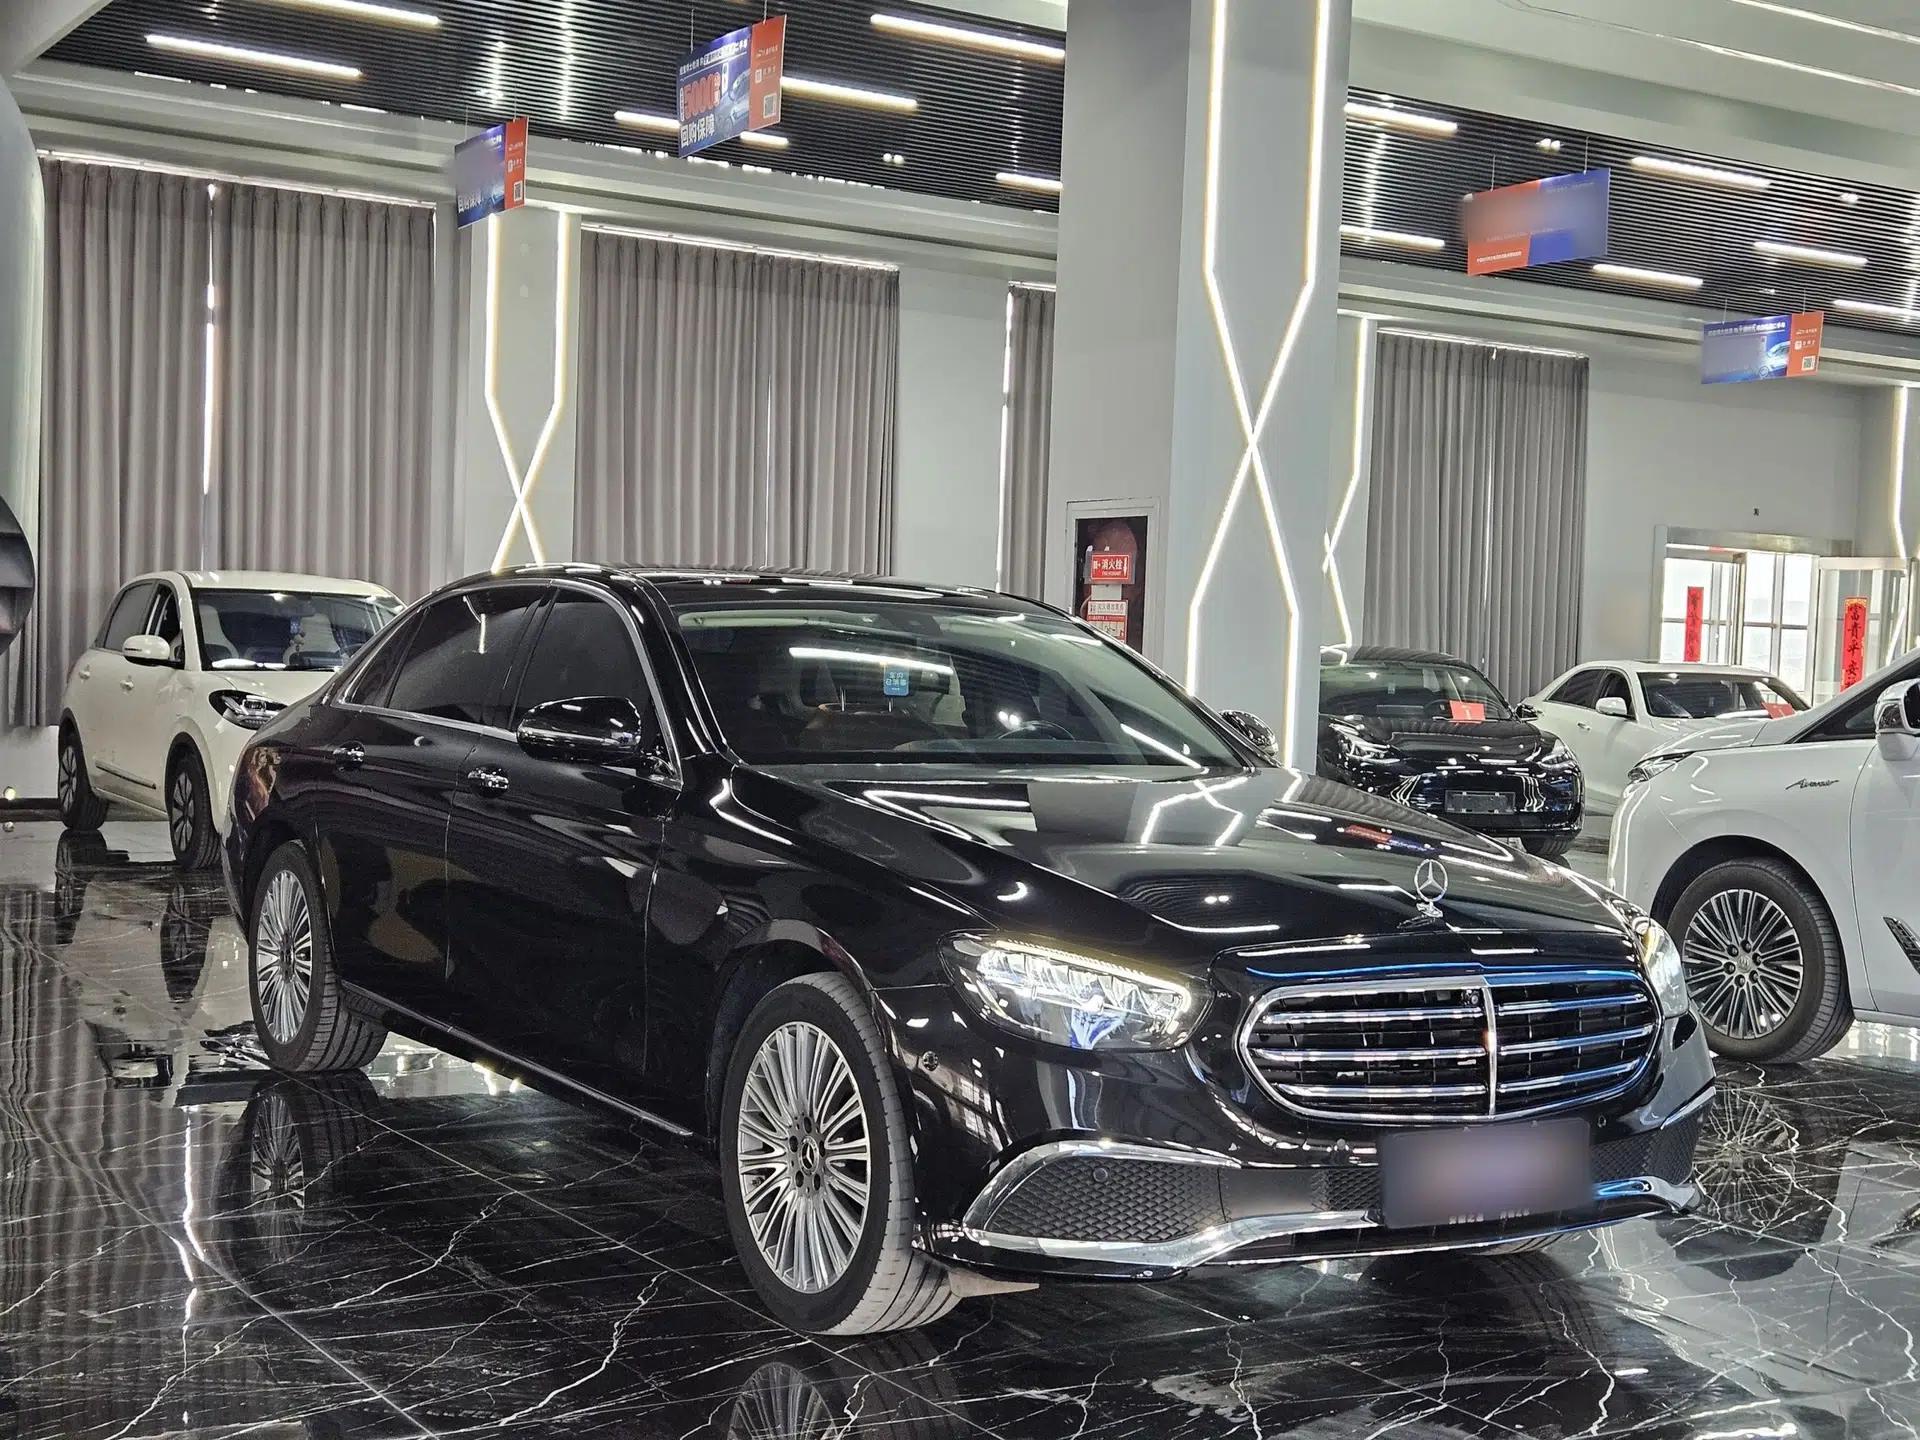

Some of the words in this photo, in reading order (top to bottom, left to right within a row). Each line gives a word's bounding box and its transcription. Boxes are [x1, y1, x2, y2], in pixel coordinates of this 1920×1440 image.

[680, 113, 715, 149] 回购保障
[1101, 558, 1123, 570] 消火栓
